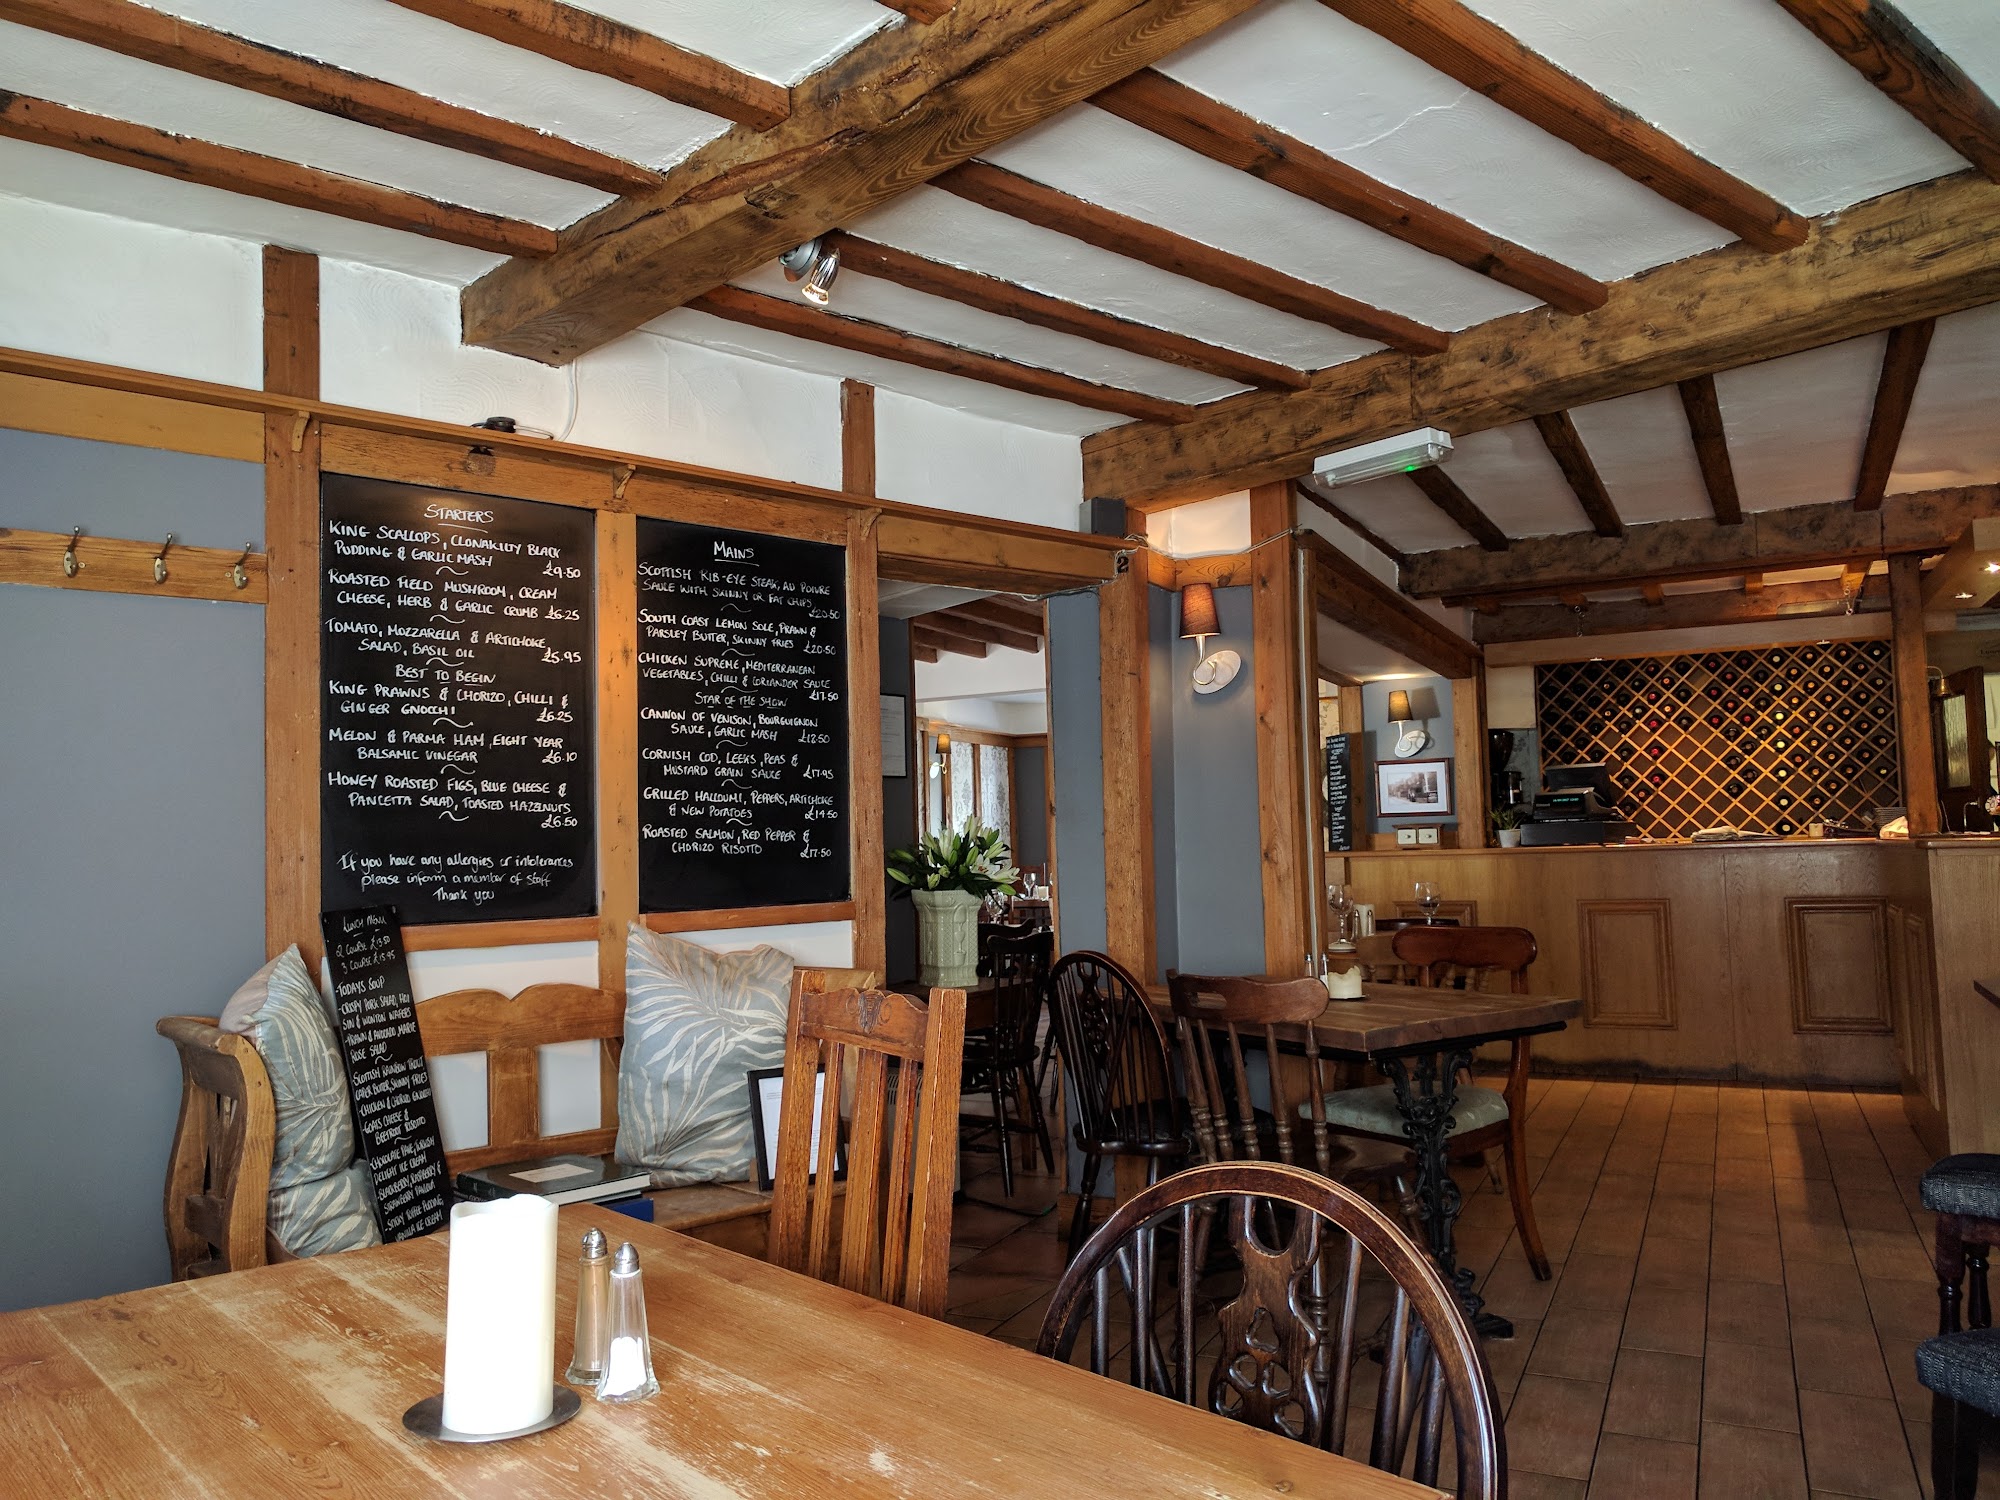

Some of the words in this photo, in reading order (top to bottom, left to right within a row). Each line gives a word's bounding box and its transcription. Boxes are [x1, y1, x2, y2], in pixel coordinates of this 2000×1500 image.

[424, 504, 494, 523] STARTERS
[329, 520, 370, 537] KING
[376, 526, 448, 550] SCALLOPS,
[527, 543, 561, 558] BLACK
[713, 540, 755, 559] MAINS
[334, 539, 393, 558] PUDDING
[411, 548, 454, 563] GARLIC
[456, 553, 493, 567] MASH
[542, 560, 581, 579] £9.50
[637, 561, 692, 581] SCOTTISH
[699, 568, 747, 586] RIB-EYE
[750, 575, 781, 591] STEAK,
[782, 581, 796, 592] AU
[800, 581, 831, 596] POIVRE
[328, 568, 391, 587] ROASTED
[396, 575, 434, 592] FIELD
[444, 581, 514, 600] MUSHROOM,
[518, 586, 557, 600] CREAM
[642, 578, 676, 593] SAUCE
[679, 584, 708, 597] WITH
[712, 587, 749, 601] SKINNY
[752, 592, 766, 602] OR
[787, 597, 813, 608] CHIPS
[336, 590, 391, 609] CHEESE,
[397, 594, 433, 609] HERB
[455, 599, 496, 615] GARLIC
[503, 605, 539, 619] CRUMB
[544, 605, 580, 620] £6.25
[325, 617, 383, 637] TOMATO,
[387, 623, 461, 641] MOZZARELLA
[485, 631, 547, 649] ARTICHOKE
[637, 608, 677, 625] SOUTH
[681, 615, 710, 627] COAST
[715, 617, 748, 631] LEMON
[752, 620, 779, 637] SOLE,
[779, 622, 808, 635] PRAWN
[358, 638, 408, 656] SALAD,
[412, 642, 449, 657] BASIL
[455, 648, 475, 658] OIL
[541, 647, 582, 664] £5.95
[645, 624, 688, 642] PARSLEY
[692, 629, 730, 647] BUTTER,
[731, 634, 768, 648] SKINNY
[771, 637, 795, 649] FRIES
[802, 640, 837, 656] £20.50
[395, 663, 429, 679] BEST
[434, 669, 450, 681] TO
[455, 669, 496, 684] BEGIN
[638, 651, 688, 666] CHICKEN
[693, 655, 746, 675] SUPREME,
[745, 660, 816, 675] MEDITERRANEAN
[642, 667, 709, 687] VEGETABLES,
[710, 671, 738, 684] CHILLI
[752, 676, 799, 690] CORIANDER
[803, 679, 831, 689] SAUCE
[328, 679, 368, 696] KING
[374, 683, 431, 699] PRAWNS
[456, 688, 512, 707] CHORIZO,
[514, 690, 553, 706] CHILLI
[694, 691, 721, 705] STAR
[758, 696, 789, 707] SHOW
[808, 689, 840, 702] £17.50
[340, 699, 391, 715] GINGER
[400, 702, 456, 716] GNOCCHI
[536, 706, 574, 723] £6.25
[640, 706, 687, 721] CANNON
[710, 712, 756, 729] VENISON,
[757, 713, 819, 728] BOURGUIGNON
[328, 726, 377, 742] MELON
[402, 730, 446, 745] PARMA
[492, 733, 529, 747] EIGHT
[533, 735, 564, 749] YEAR
[670, 722, 712, 738] SAUCE,
[713, 725, 746, 738] GARLIC
[751, 729, 778, 741] MASH
[356, 746, 420, 760] BALSAMIC
[425, 749, 479, 764] VINEGAR
[541, 749, 578, 765] £6.10
[641, 747, 691, 761] CORNISH
[698, 751, 722, 765] COD,
[725, 752, 764, 768] LEEKS,
[763, 752, 786, 765] PEAS
[327, 770, 378, 790] HONEY
[384, 774, 439, 792] ROASTED
[447, 777, 478, 796] FIGS,
[480, 779, 508, 793] BLUE
[512, 781, 551, 794] CHEESE
[663, 763, 709, 777] MUSTARD
[714, 766, 744, 778] GRAIN
[751, 768, 782, 780] SAUCE
[802, 763, 835, 780] £17.95
[347, 791, 413, 807] PANCETTA
[419, 794, 459, 812] SALAD,
[461, 796, 504, 811] TOASTED
[509, 800, 572, 815] HAZELNUTS
[643, 786, 690, 801] GRILLED
[694, 790, 747, 806] HALLOUMI,
[750, 789, 788, 807] PEPPERS,
[541, 813, 578, 829] £6.50
[680, 803, 705, 816] NEW
[709, 804, 753, 819] POTATOES
[641, 823, 688, 839] ROASTED
[694, 827, 741, 845] SALMON,
[764, 826, 797, 842] PEPPER
[671, 841, 715, 854] CHORIZO
[721, 842, 763, 855] RISOTTO
[799, 843, 832, 859] £17.50
[336, 849, 359, 872] If
[360, 857, 383, 876] you
[389, 853, 417, 866] have
[420, 855, 443, 874] any
[446, 852, 495, 874] allergies
[515, 854, 574, 869] intolerances
[361, 873, 401, 893] please
[406, 870, 448, 886] inform
[463, 872, 507, 884] member
[509, 871, 523, 886] of
[526, 871, 552, 887] staff
[432, 886, 468, 902] Thank
[472, 889, 495, 906] you
[368, 975, 386, 991] SOUP
[342, 1018, 355, 1031] SIN
[361, 1012, 387, 1026] WONTON
